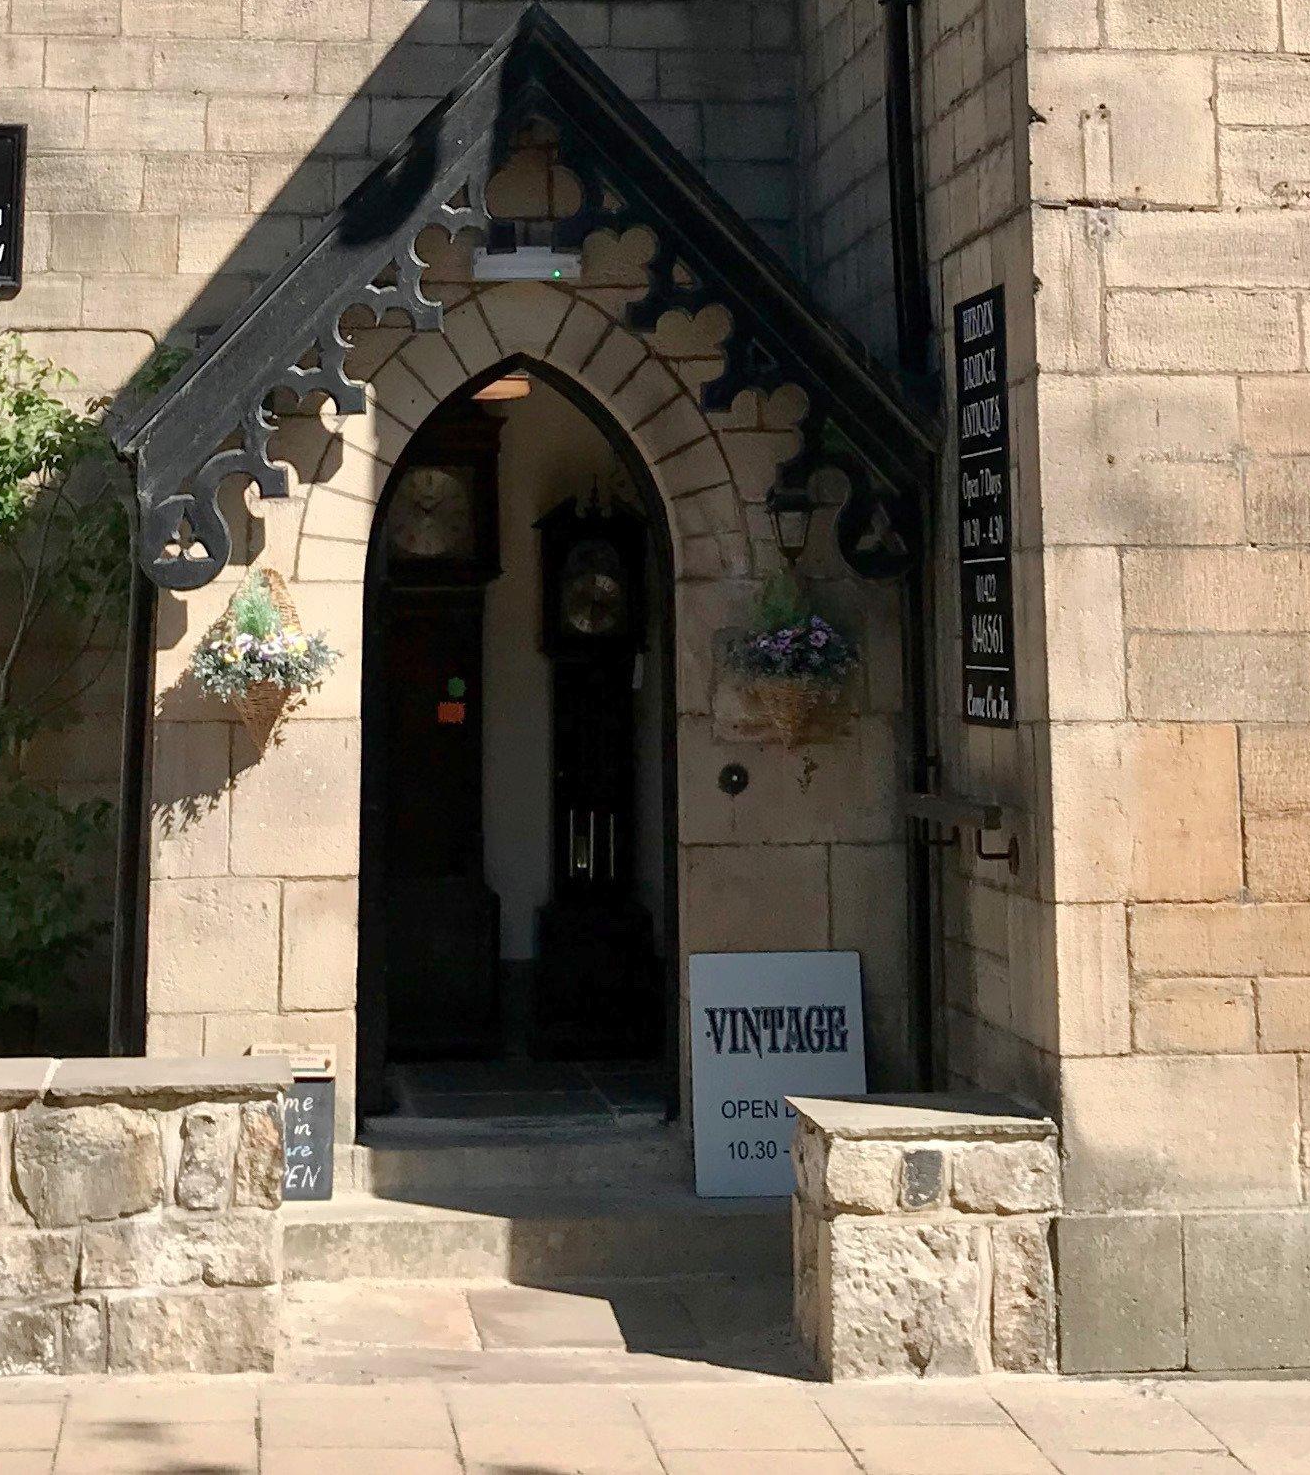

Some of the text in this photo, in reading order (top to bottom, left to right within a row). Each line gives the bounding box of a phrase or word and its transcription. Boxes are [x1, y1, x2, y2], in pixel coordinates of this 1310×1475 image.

[962, 299, 995, 343] HEBDEN
[963, 347, 997, 391] BRIDGE
[961, 394, 1001, 440] ANTIQUES
[962, 472, 979, 507] Open
[985, 467, 1002, 503] Days
[704, 1004, 849, 1059] VINTAGE
[284, 1096, 314, 1113] me
[721, 1099, 779, 1119] OPEN
[294, 1118, 312, 1136] in
[728, 1140, 777, 1160] 10.30
[284, 1164, 322, 1190] EN
